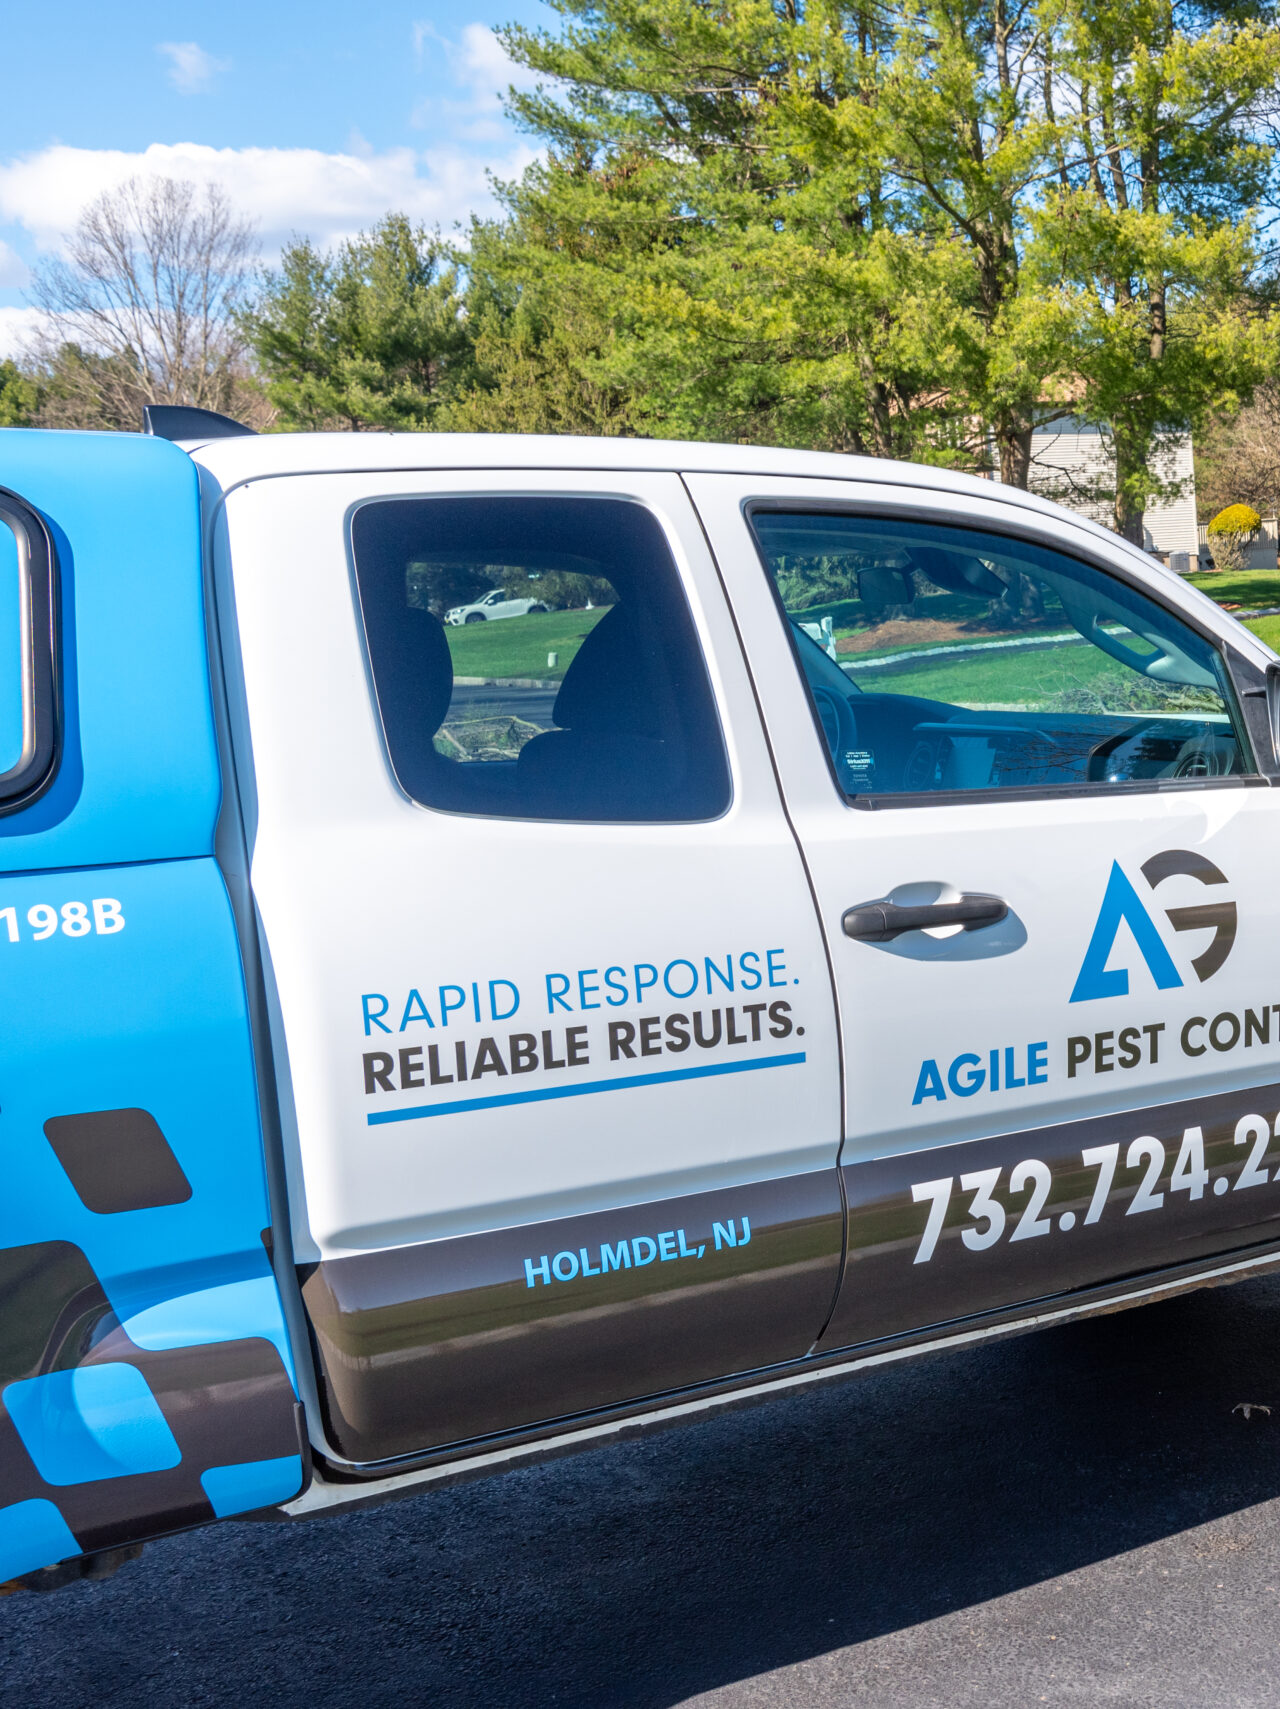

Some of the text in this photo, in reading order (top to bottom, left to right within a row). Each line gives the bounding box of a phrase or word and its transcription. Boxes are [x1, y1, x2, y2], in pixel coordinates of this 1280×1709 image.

[0, 897, 126, 943] 198B
[361, 948, 800, 1036] RAPID RESPONSE.
[362, 1000, 806, 1095] RELIABLE RESULTS.
[911, 1041, 1049, 1106] AGILE
[1067, 1022, 1166, 1079] PEST
[523, 1216, 751, 1288] HOLMDEL, NJ
